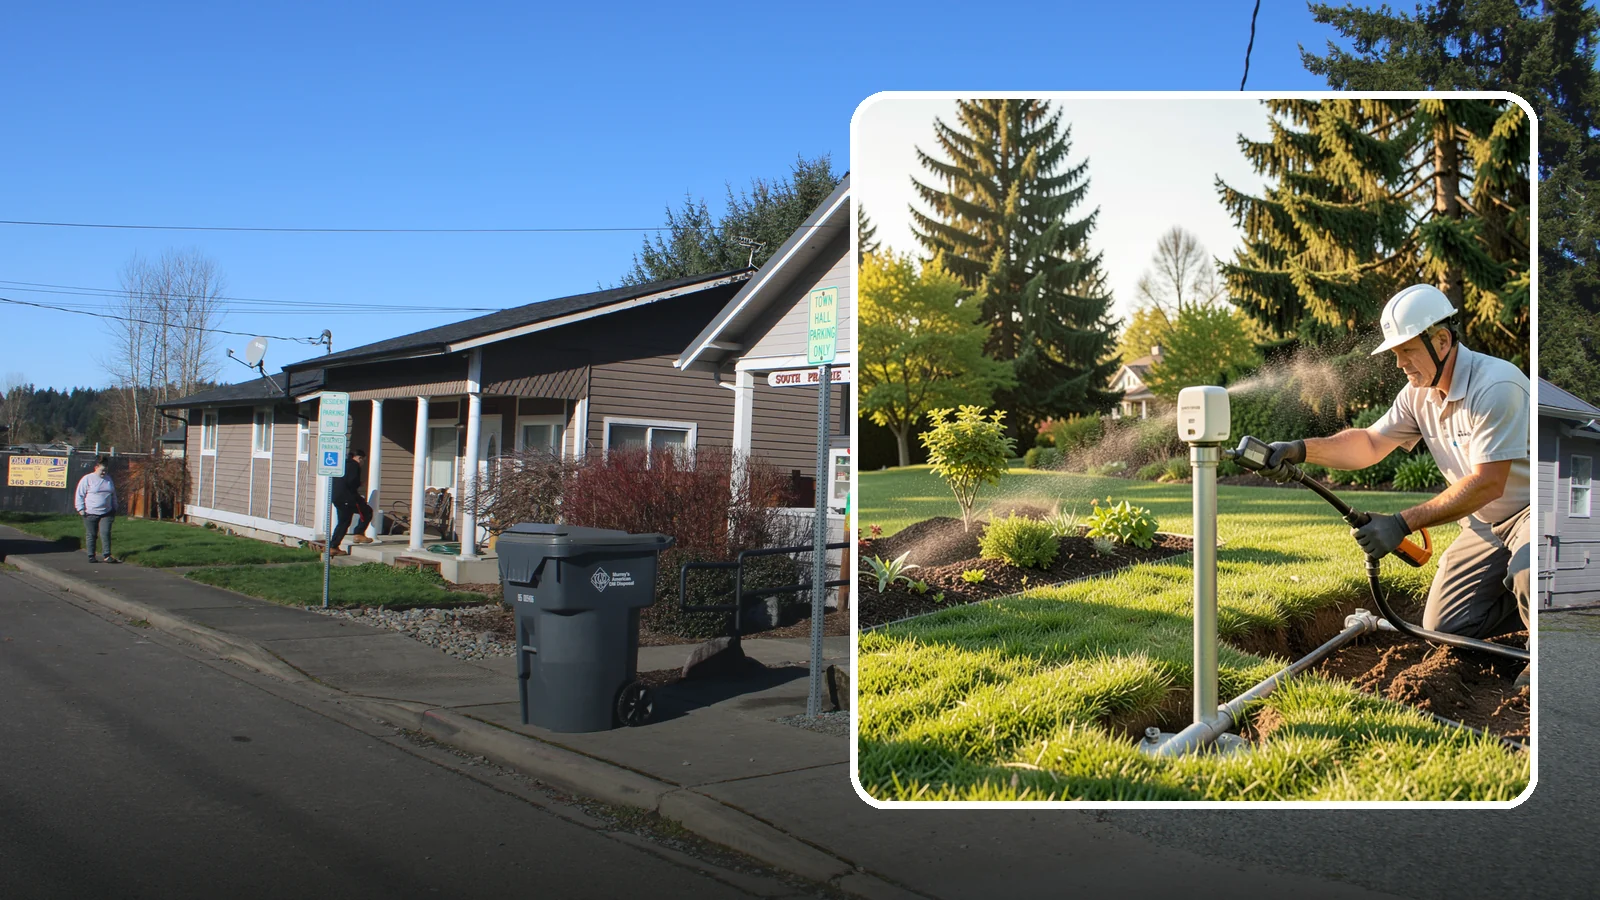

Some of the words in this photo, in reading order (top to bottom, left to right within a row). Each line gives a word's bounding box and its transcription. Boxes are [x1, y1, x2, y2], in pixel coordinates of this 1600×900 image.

[815, 295, 833, 308] TOWN
[814, 312, 831, 324] HALL
[810, 326, 836, 340] PARKING
[814, 344, 831, 357] ONLY
[776, 374, 801, 384] SOUTH
[11, 457, 27, 465] COAST
